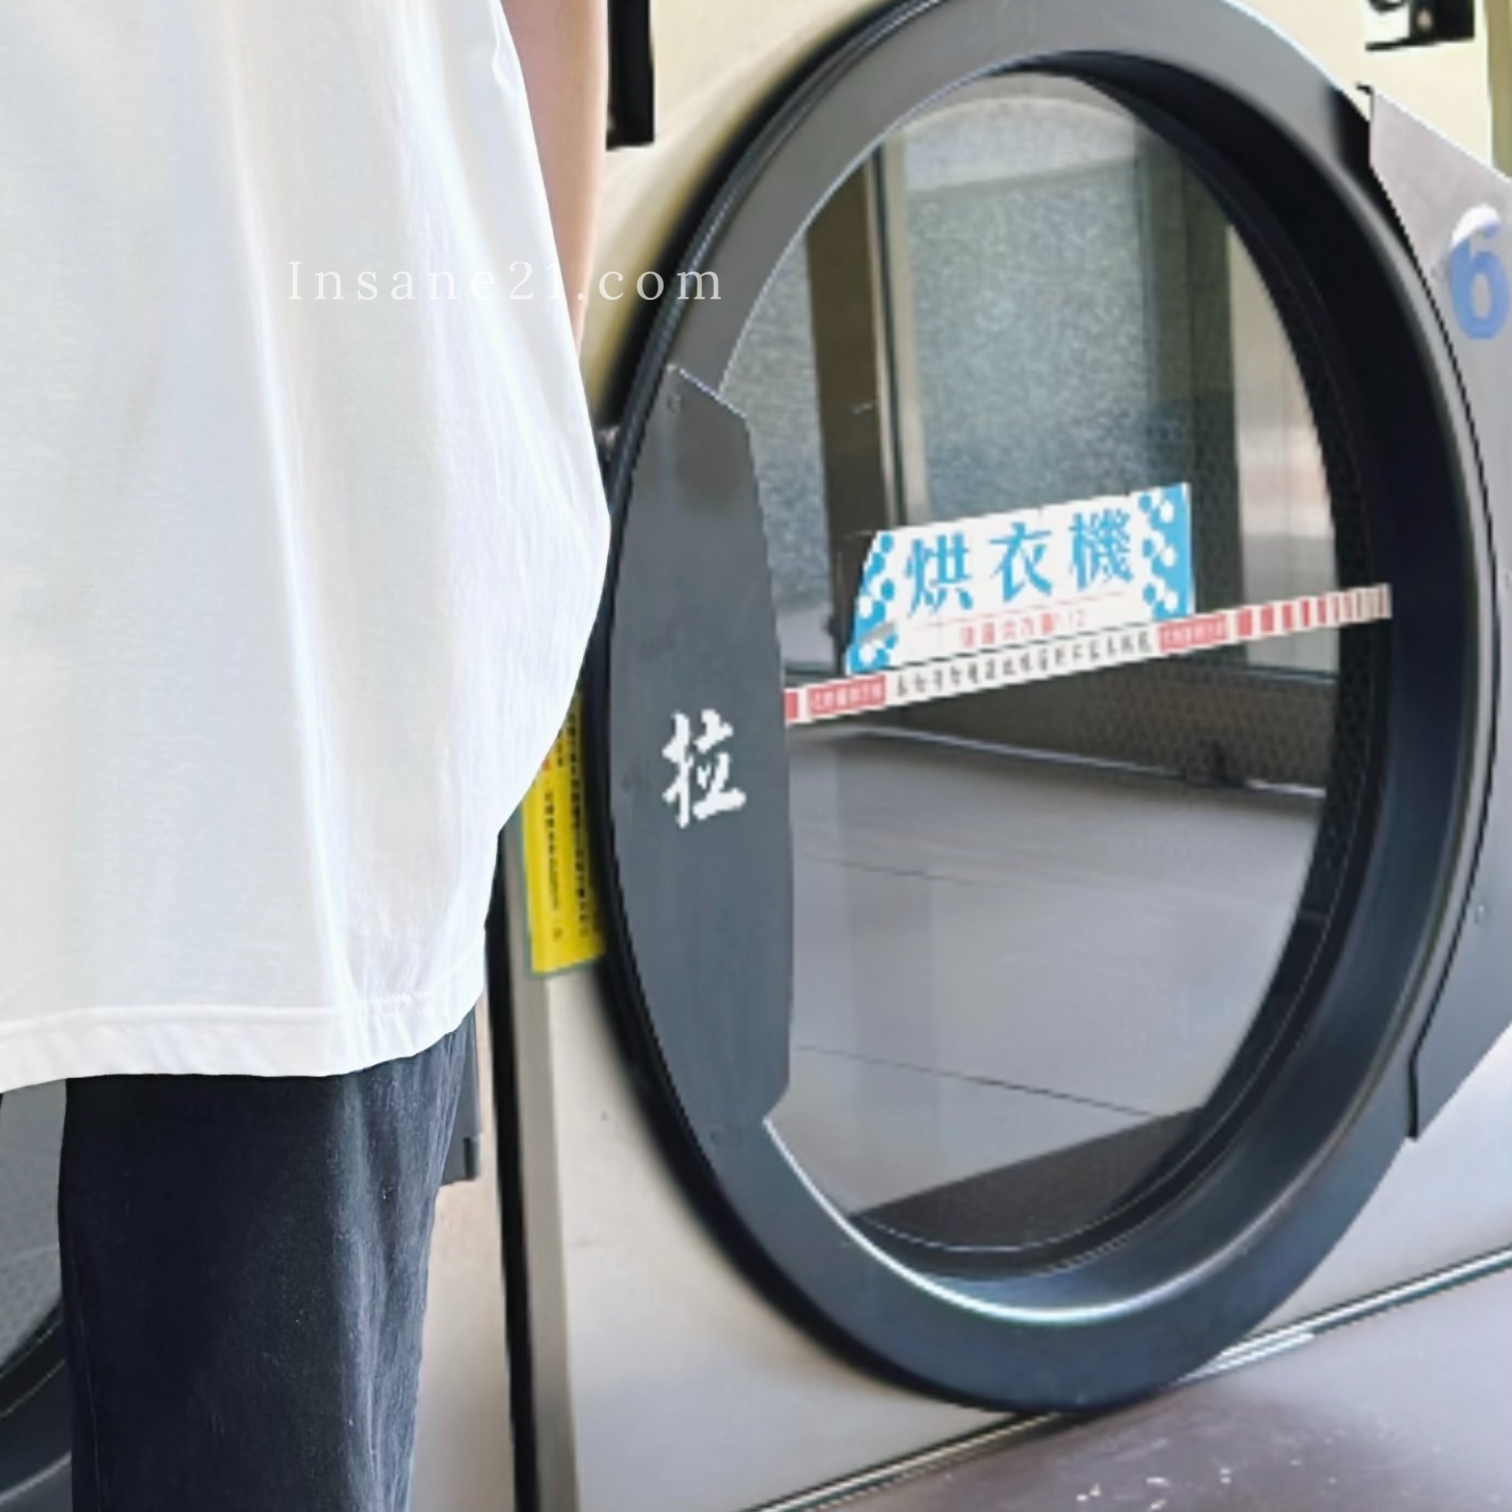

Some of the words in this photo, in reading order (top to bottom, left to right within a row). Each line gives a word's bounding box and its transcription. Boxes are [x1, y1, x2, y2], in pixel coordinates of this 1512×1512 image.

[1449, 203, 1510, 341] 6
[905, 508, 1134, 617] 烘衣機
[660, 709, 747, 828] 拉
